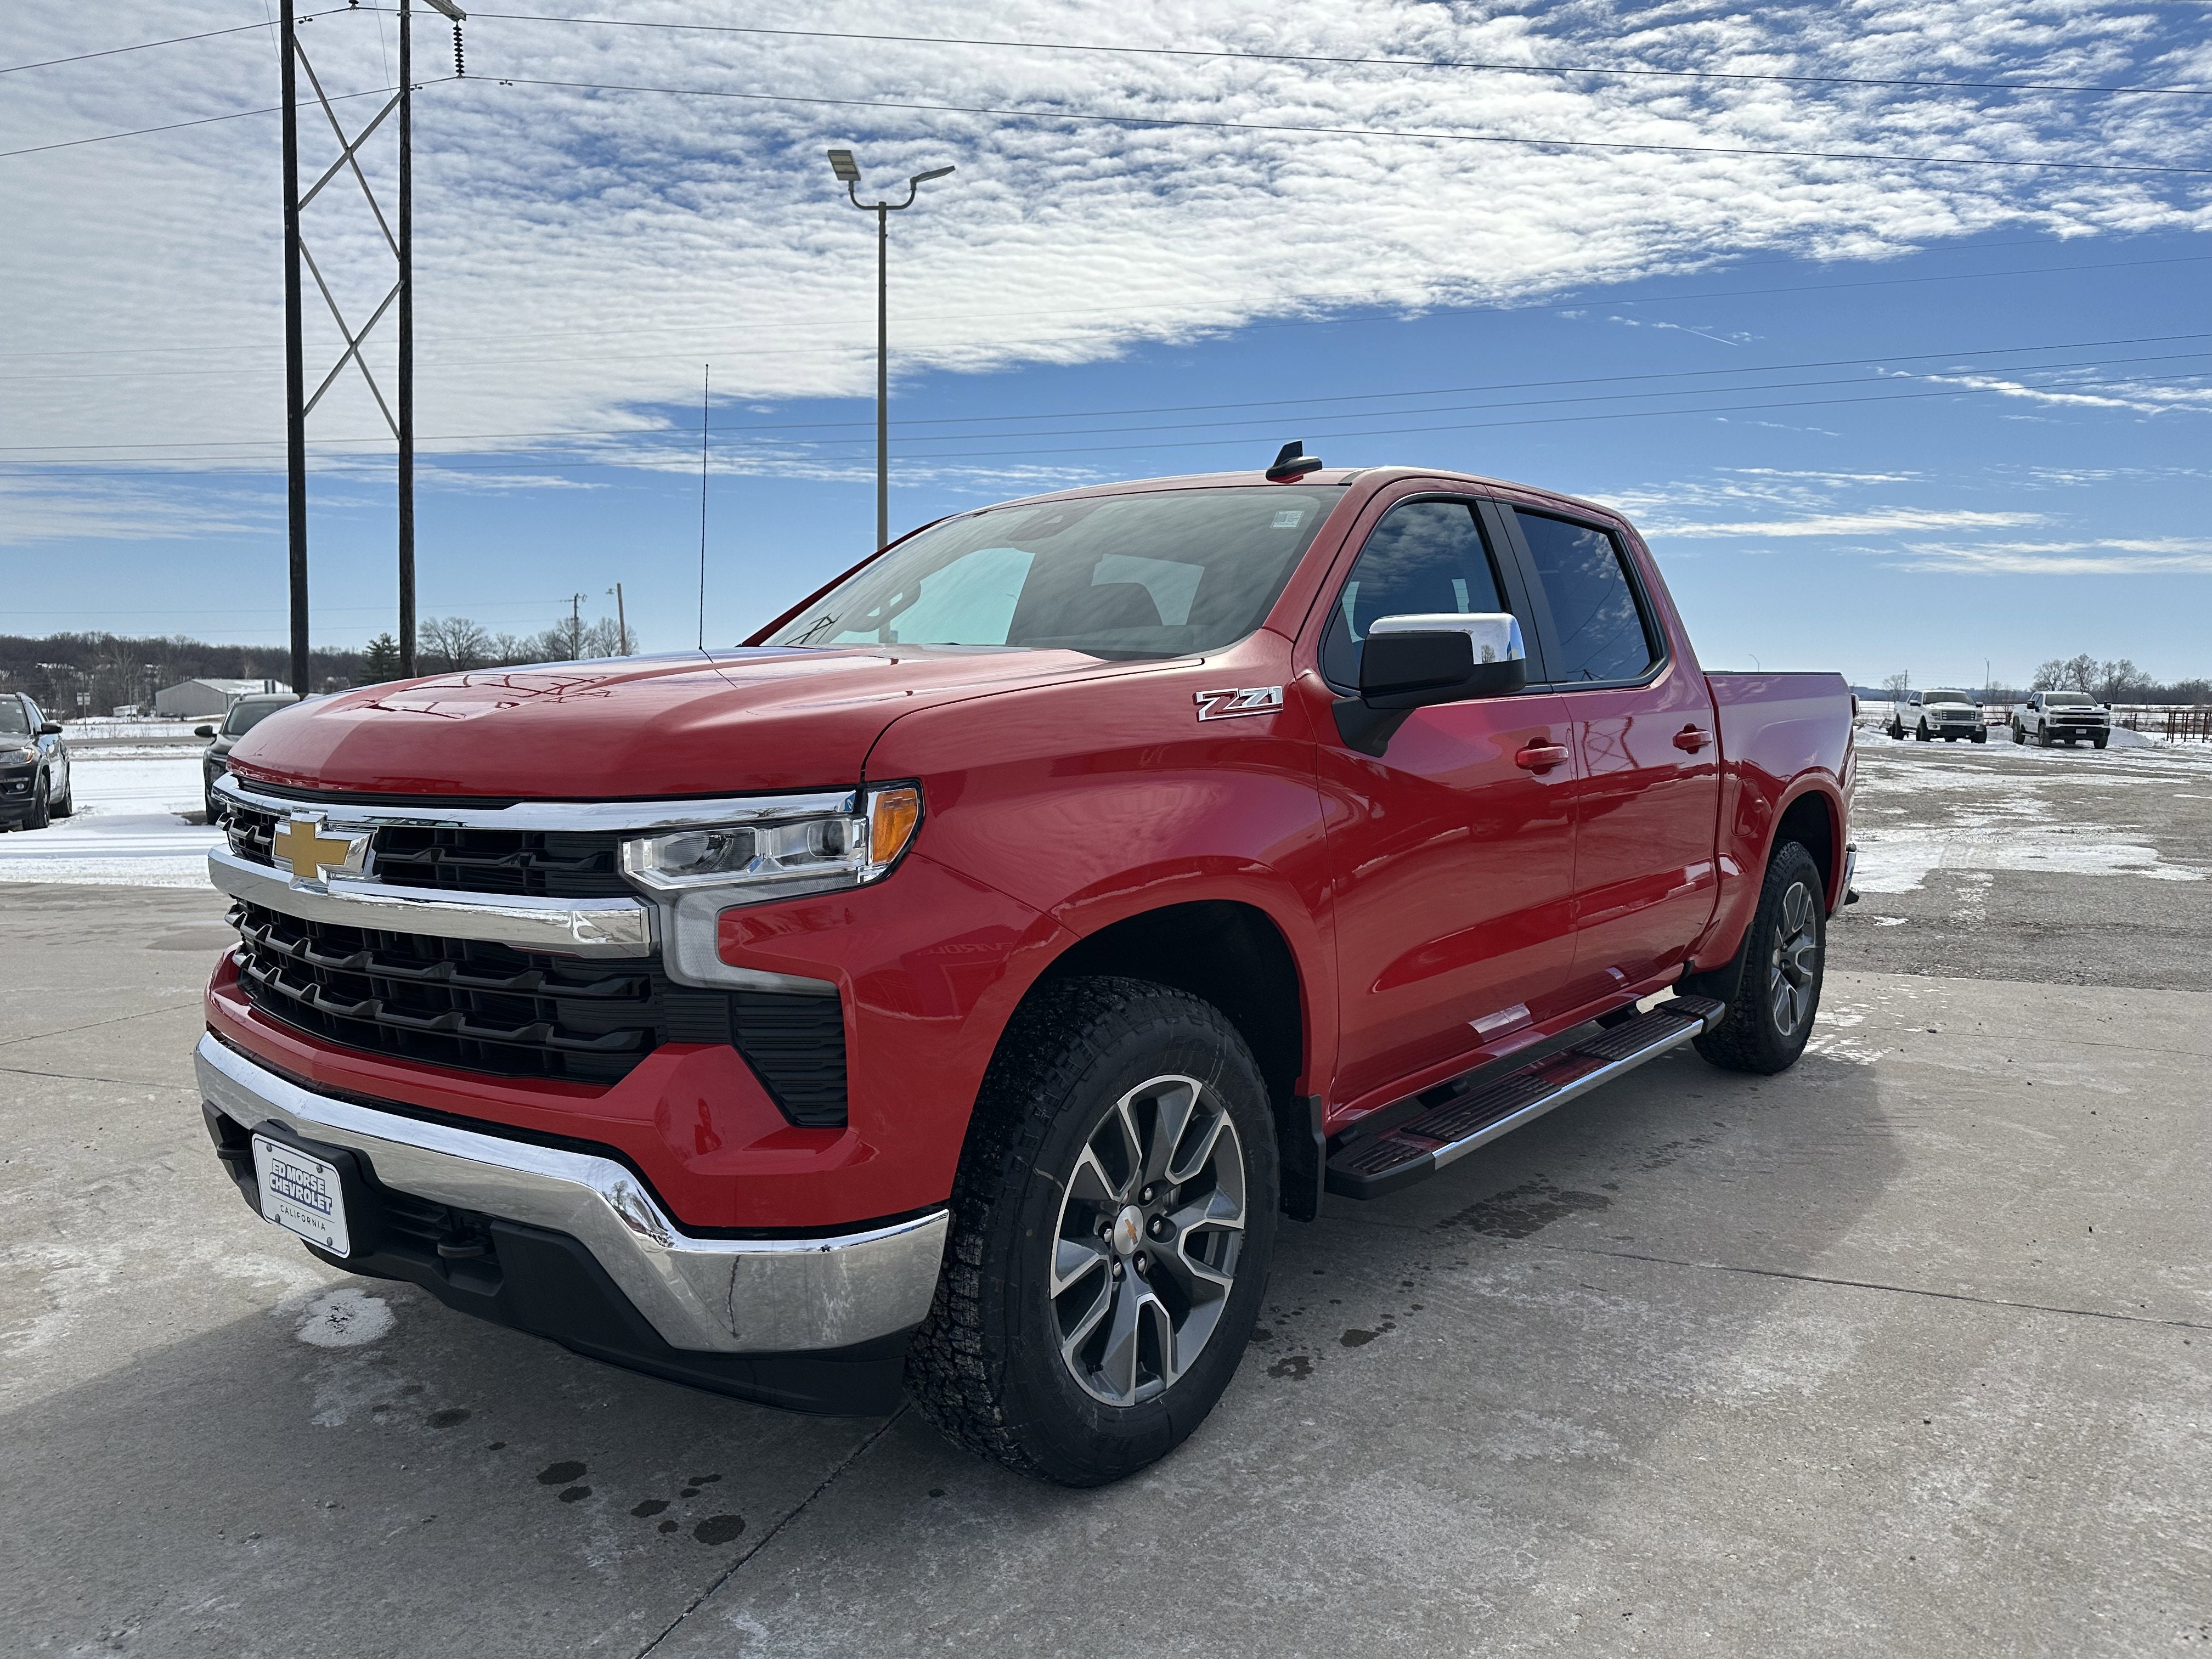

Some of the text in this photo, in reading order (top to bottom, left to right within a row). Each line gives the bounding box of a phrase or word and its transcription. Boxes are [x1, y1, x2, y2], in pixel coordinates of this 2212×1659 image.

[1193, 685, 1284, 722] Z71
[269, 1172, 332, 1214] CHEVROLET
[272, 1158, 325, 1195] ED MORSE
[280, 1204, 326, 1232] CALIFORNIA
